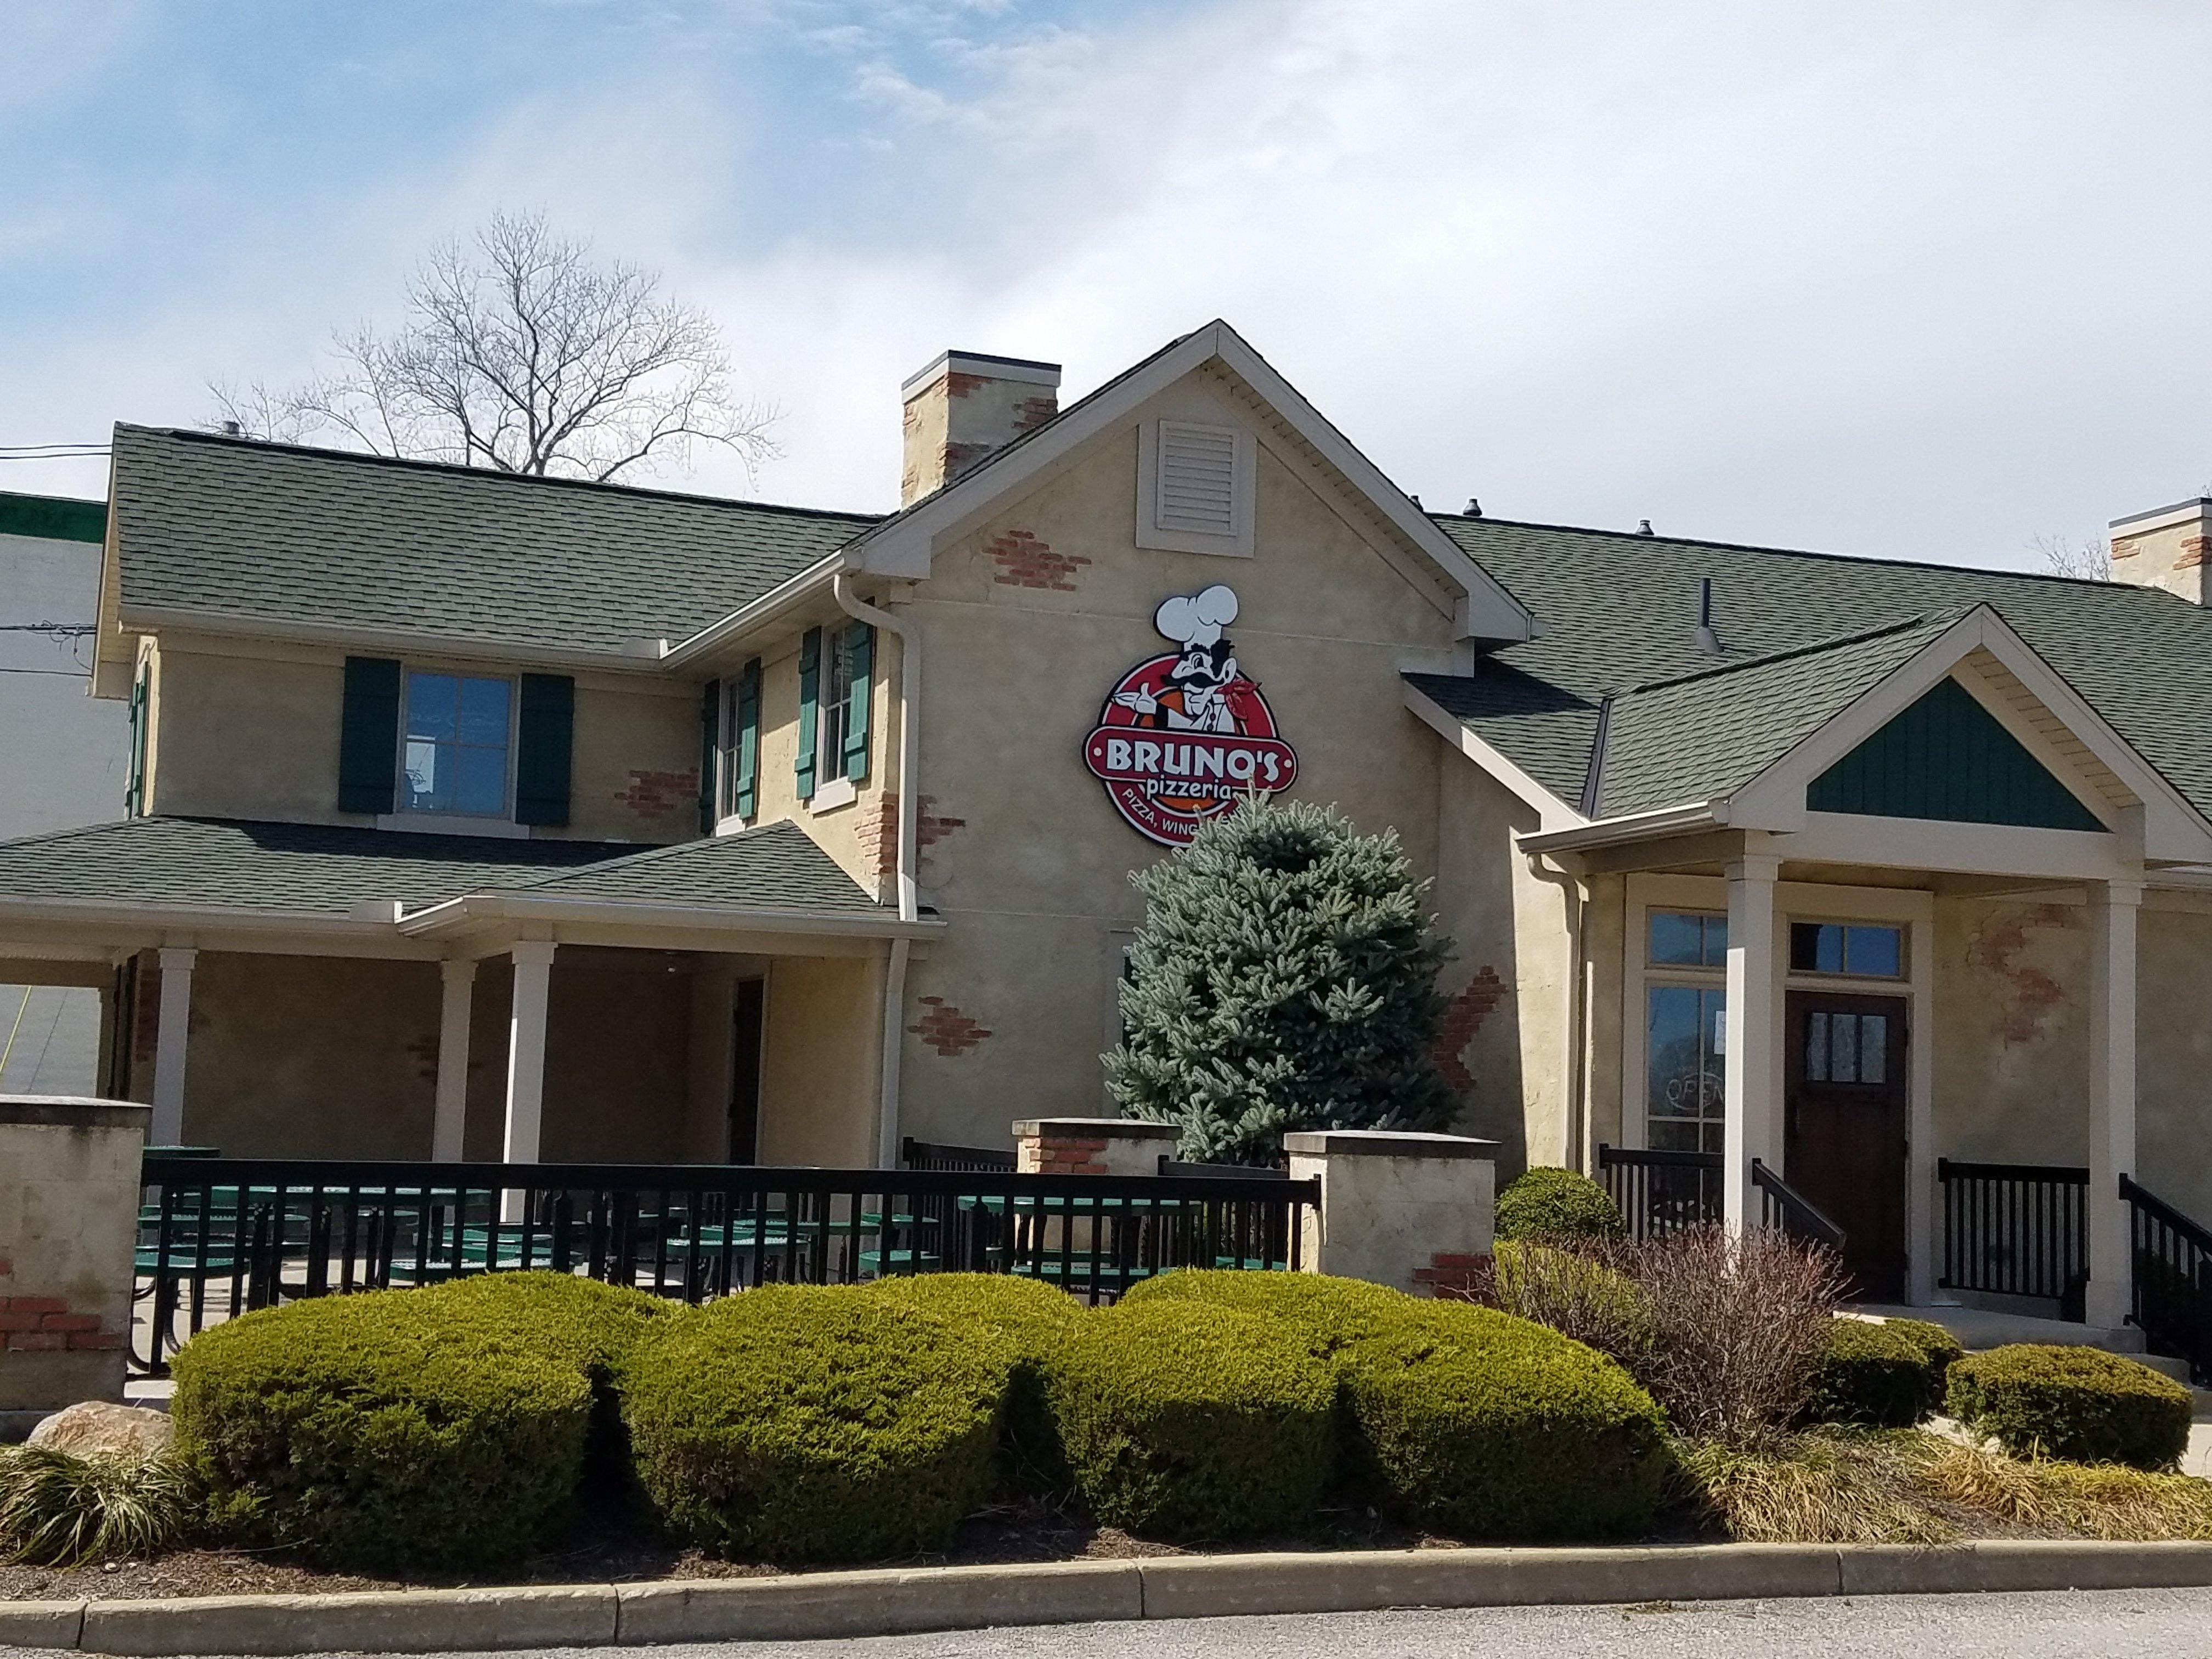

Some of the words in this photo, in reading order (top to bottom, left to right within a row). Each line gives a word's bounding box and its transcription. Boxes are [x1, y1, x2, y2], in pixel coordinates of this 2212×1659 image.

[1107, 738, 1279, 782] BRUNO'S
[1146, 774, 1232, 800] pizzeria
[1122, 788, 1158, 828] PIZZA,
[1162, 817, 1200, 836] WING
